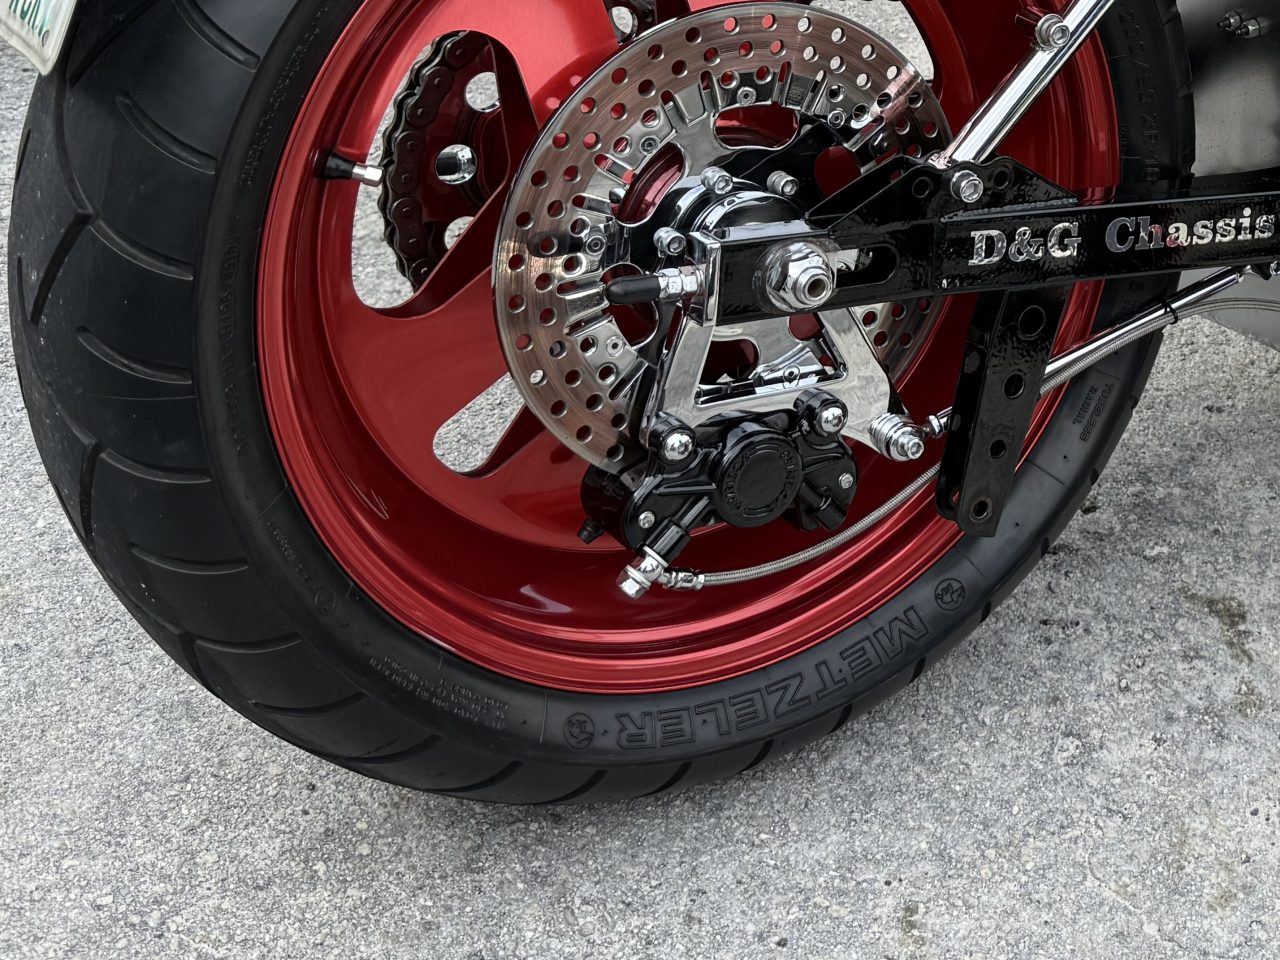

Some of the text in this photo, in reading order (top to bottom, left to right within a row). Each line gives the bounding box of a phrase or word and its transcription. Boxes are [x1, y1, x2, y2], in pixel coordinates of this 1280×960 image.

[967, 206, 1276, 267] D&G Chassis
[615, 605, 930, 751] METZELER
